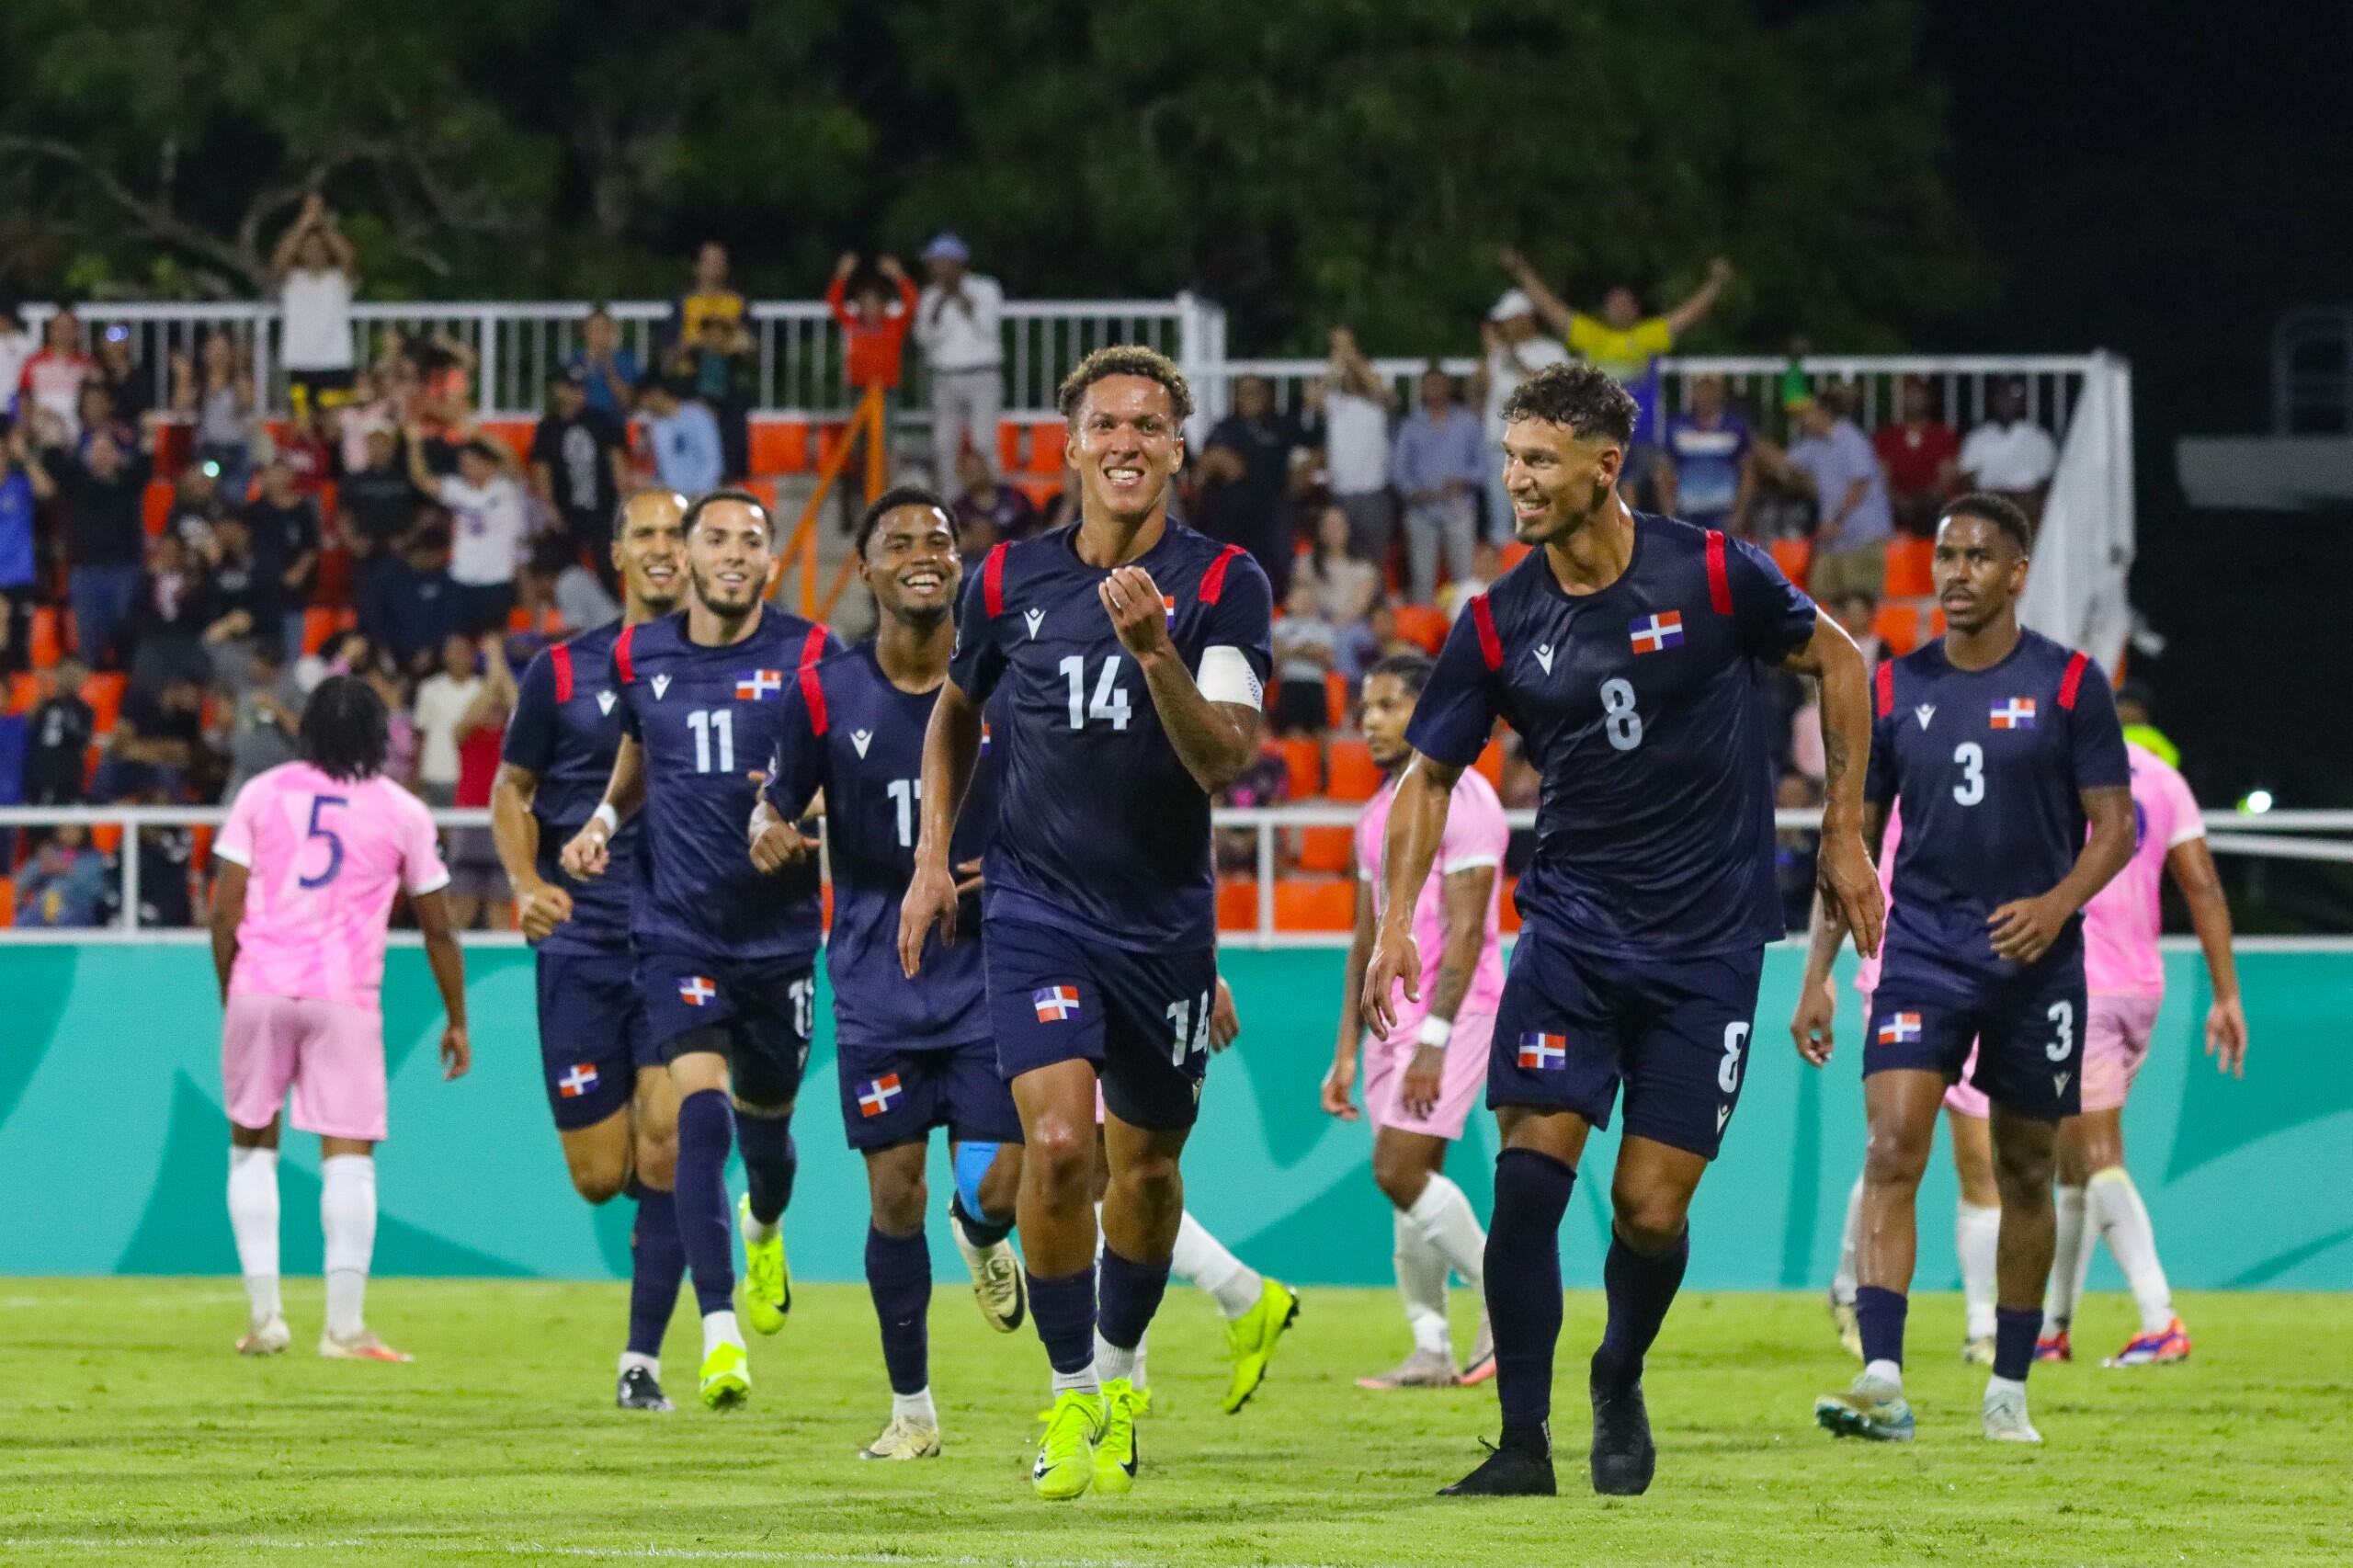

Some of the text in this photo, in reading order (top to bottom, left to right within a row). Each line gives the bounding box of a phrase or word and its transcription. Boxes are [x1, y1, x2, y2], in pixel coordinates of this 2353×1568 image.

[1059, 654, 1132, 731] 14
[1600, 678, 1643, 751] 8
[687, 708, 734, 774] 11
[1953, 741, 1985, 806] 3
[299, 794, 348, 889] 5
[887, 778, 921, 847] 1
[1166, 989, 1211, 1067] 14
[1718, 1021, 1750, 1094] 8
[2046, 1001, 2073, 1062] 3
